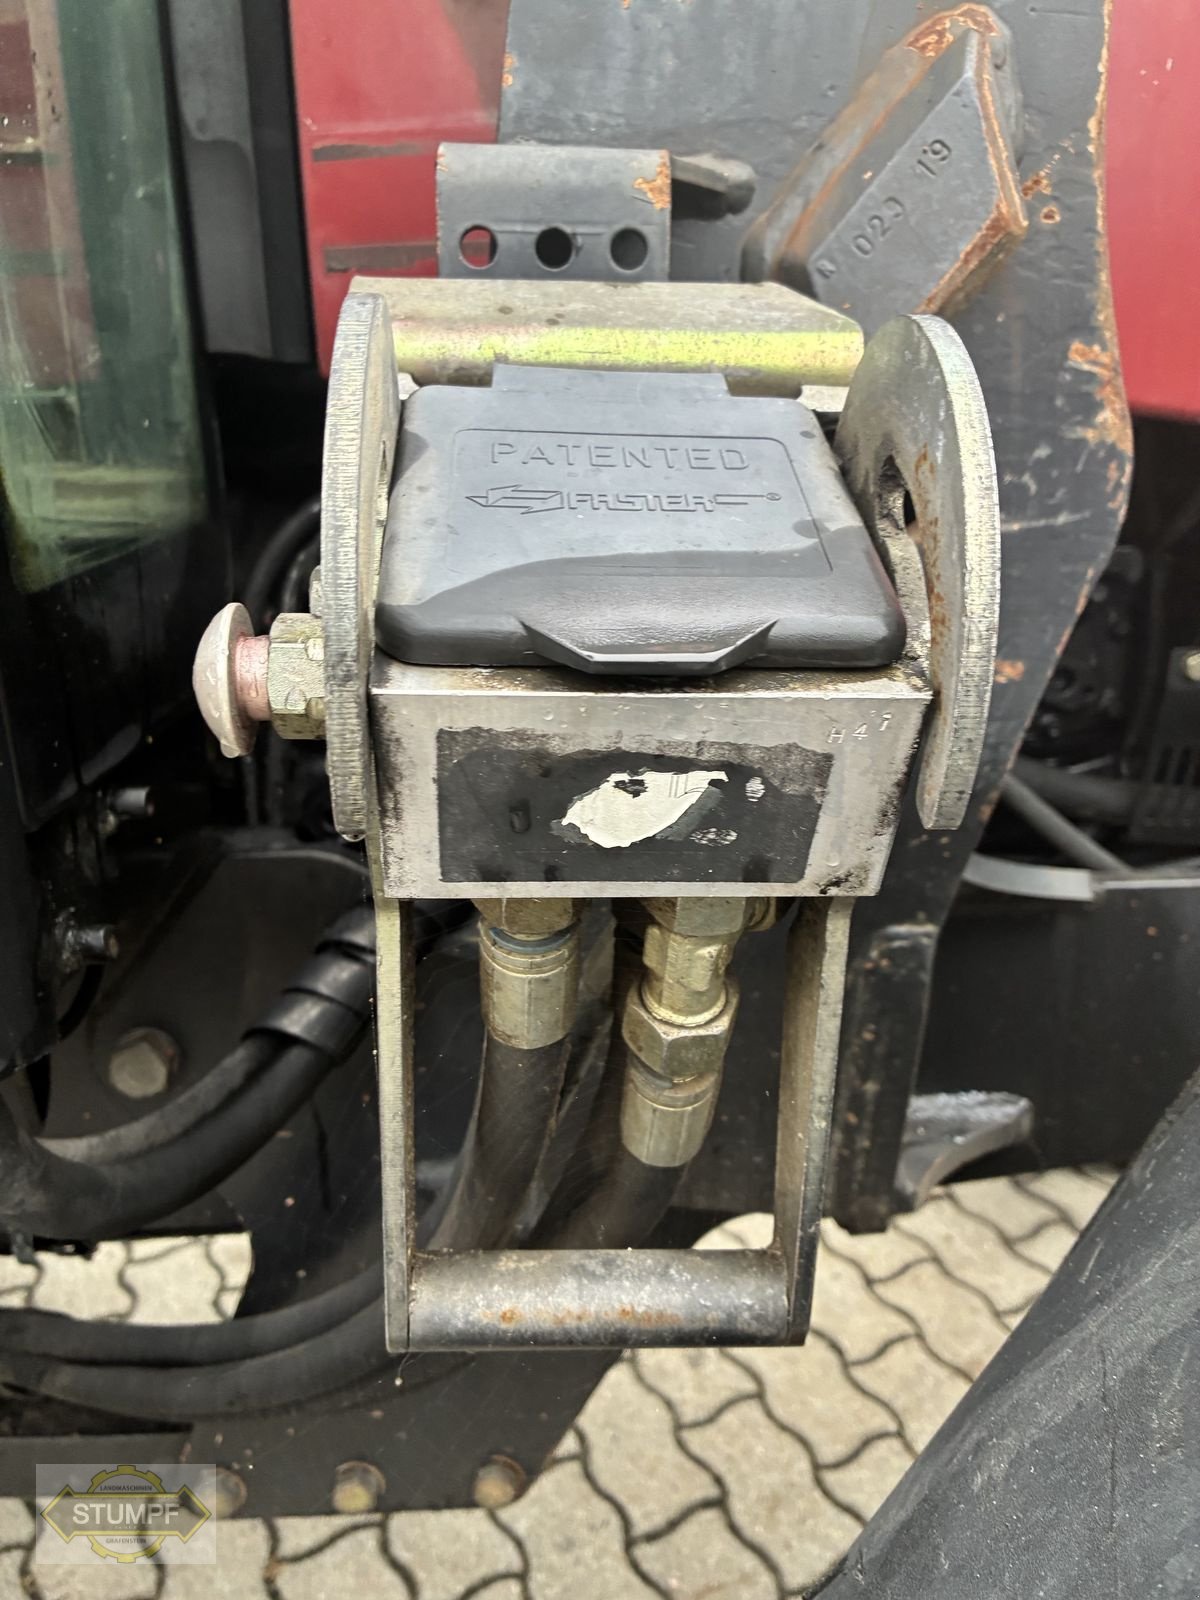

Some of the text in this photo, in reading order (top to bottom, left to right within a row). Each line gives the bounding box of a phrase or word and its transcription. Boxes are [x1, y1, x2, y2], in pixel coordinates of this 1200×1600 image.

[490, 442, 750, 471] PATENTED
[565, 491, 716, 513] FASTER
[826, 710, 893, 744] H47
